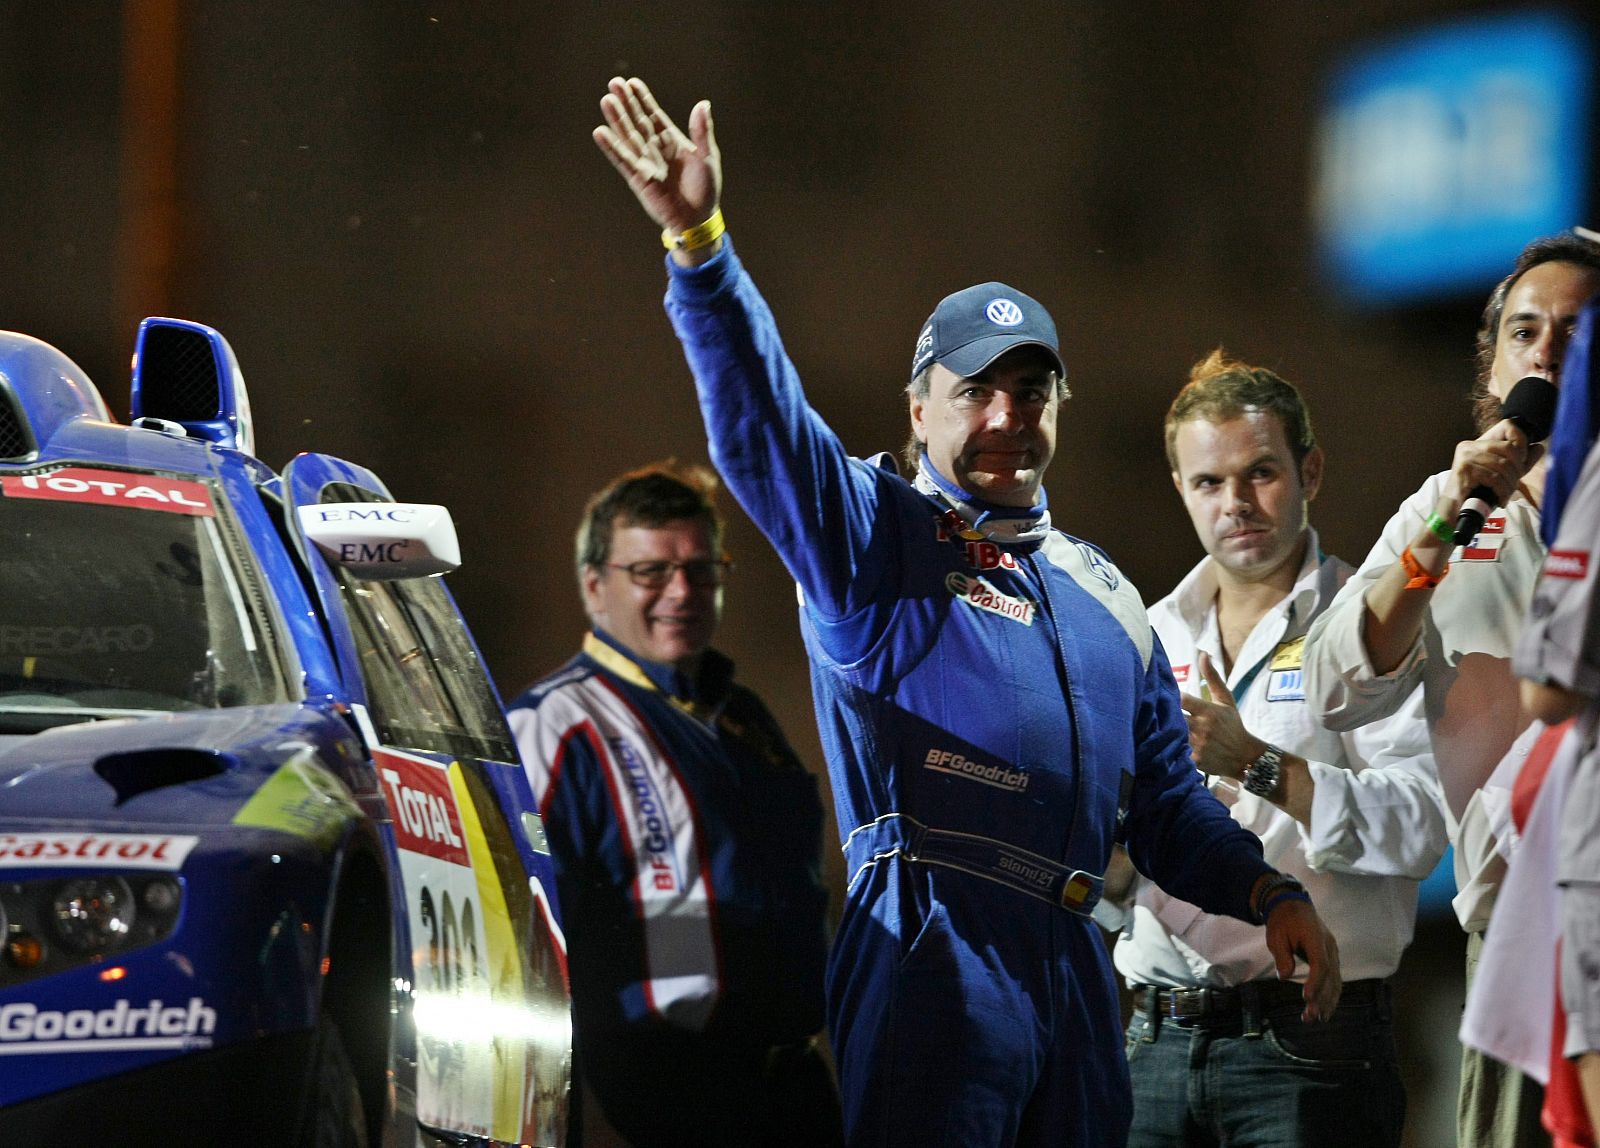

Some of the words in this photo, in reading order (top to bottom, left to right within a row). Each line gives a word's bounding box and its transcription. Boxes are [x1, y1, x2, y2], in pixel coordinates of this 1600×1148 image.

[21, 465, 208, 508] TOTAL
[969, 582, 1032, 621] Castrol
[926, 747, 1030, 788] BFGoodrich
[381, 767, 463, 849] TOTAL
